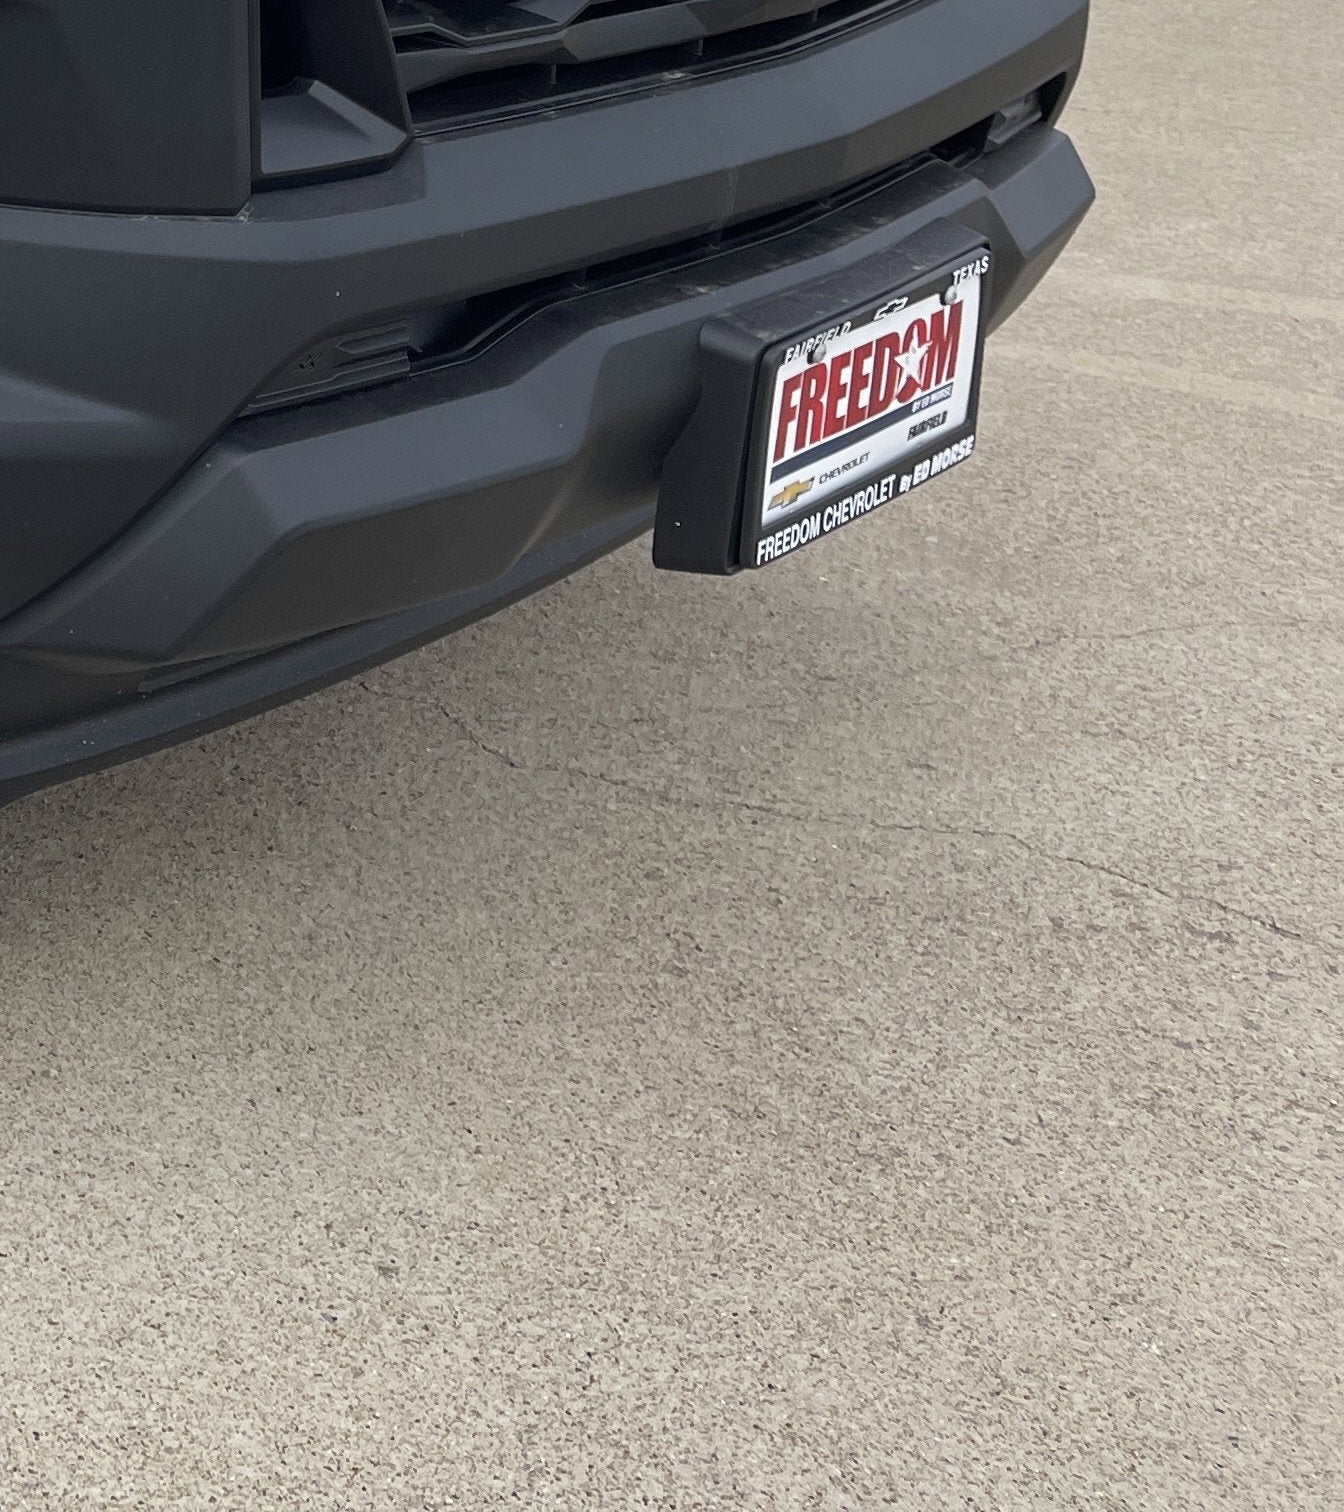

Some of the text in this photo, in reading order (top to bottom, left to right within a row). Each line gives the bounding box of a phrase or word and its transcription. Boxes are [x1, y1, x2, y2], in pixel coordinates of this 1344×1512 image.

[784, 255, 990, 365] FAIRFIELD TEXAS
[772, 301, 963, 465] FREEDOM
[755, 512, 822, 567] FREEDOM
[822, 473, 897, 533] CHEVROLET
[912, 459, 931, 486] ED
[930, 434, 975, 477] MORSE
[818, 451, 871, 485] CHEVROLET
